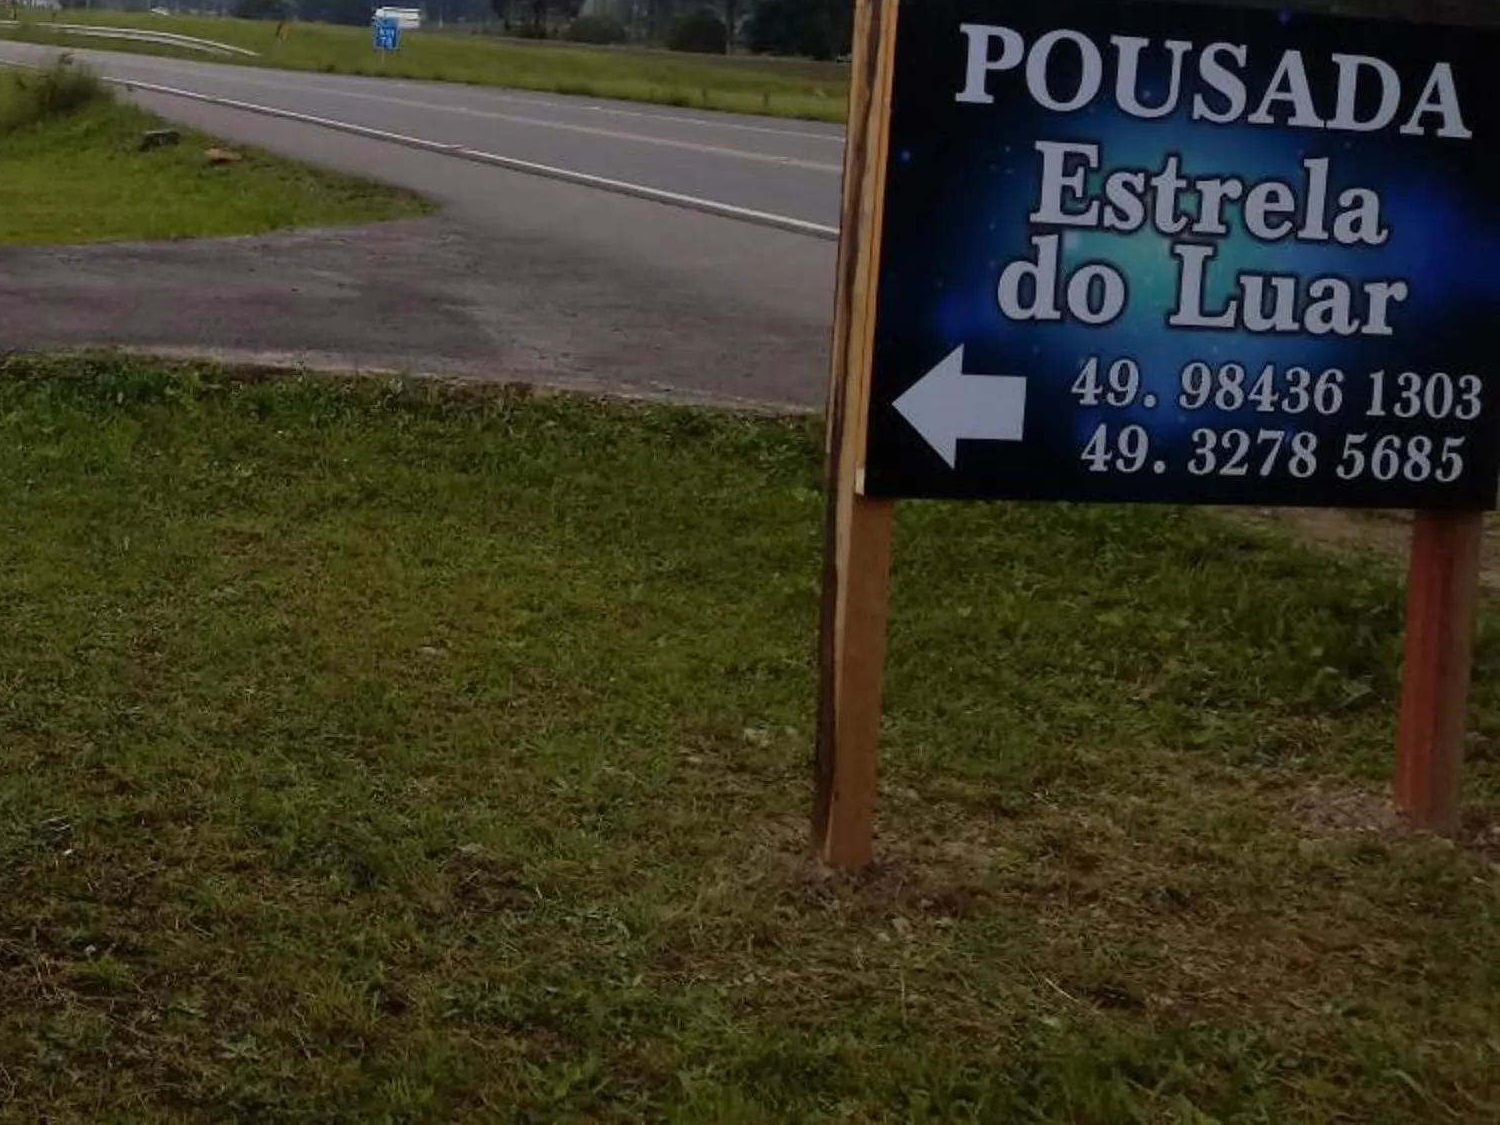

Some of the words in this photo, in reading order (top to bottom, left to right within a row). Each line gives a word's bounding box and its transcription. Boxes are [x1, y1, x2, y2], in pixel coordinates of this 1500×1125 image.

[955, 22, 1473, 139] POUSADA
[1029, 140, 1388, 245] Estrela
[998, 235, 1126, 323] do
[1169, 244, 1408, 336] Luar
[1071, 358, 1157, 408] 49.
[1179, 363, 1344, 414] 98436
[1366, 371, 1483, 421] 1303
[1080, 425, 1167, 474] 49.
[1188, 429, 1318, 478] 3278
[1336, 435, 1466, 482] 5685
